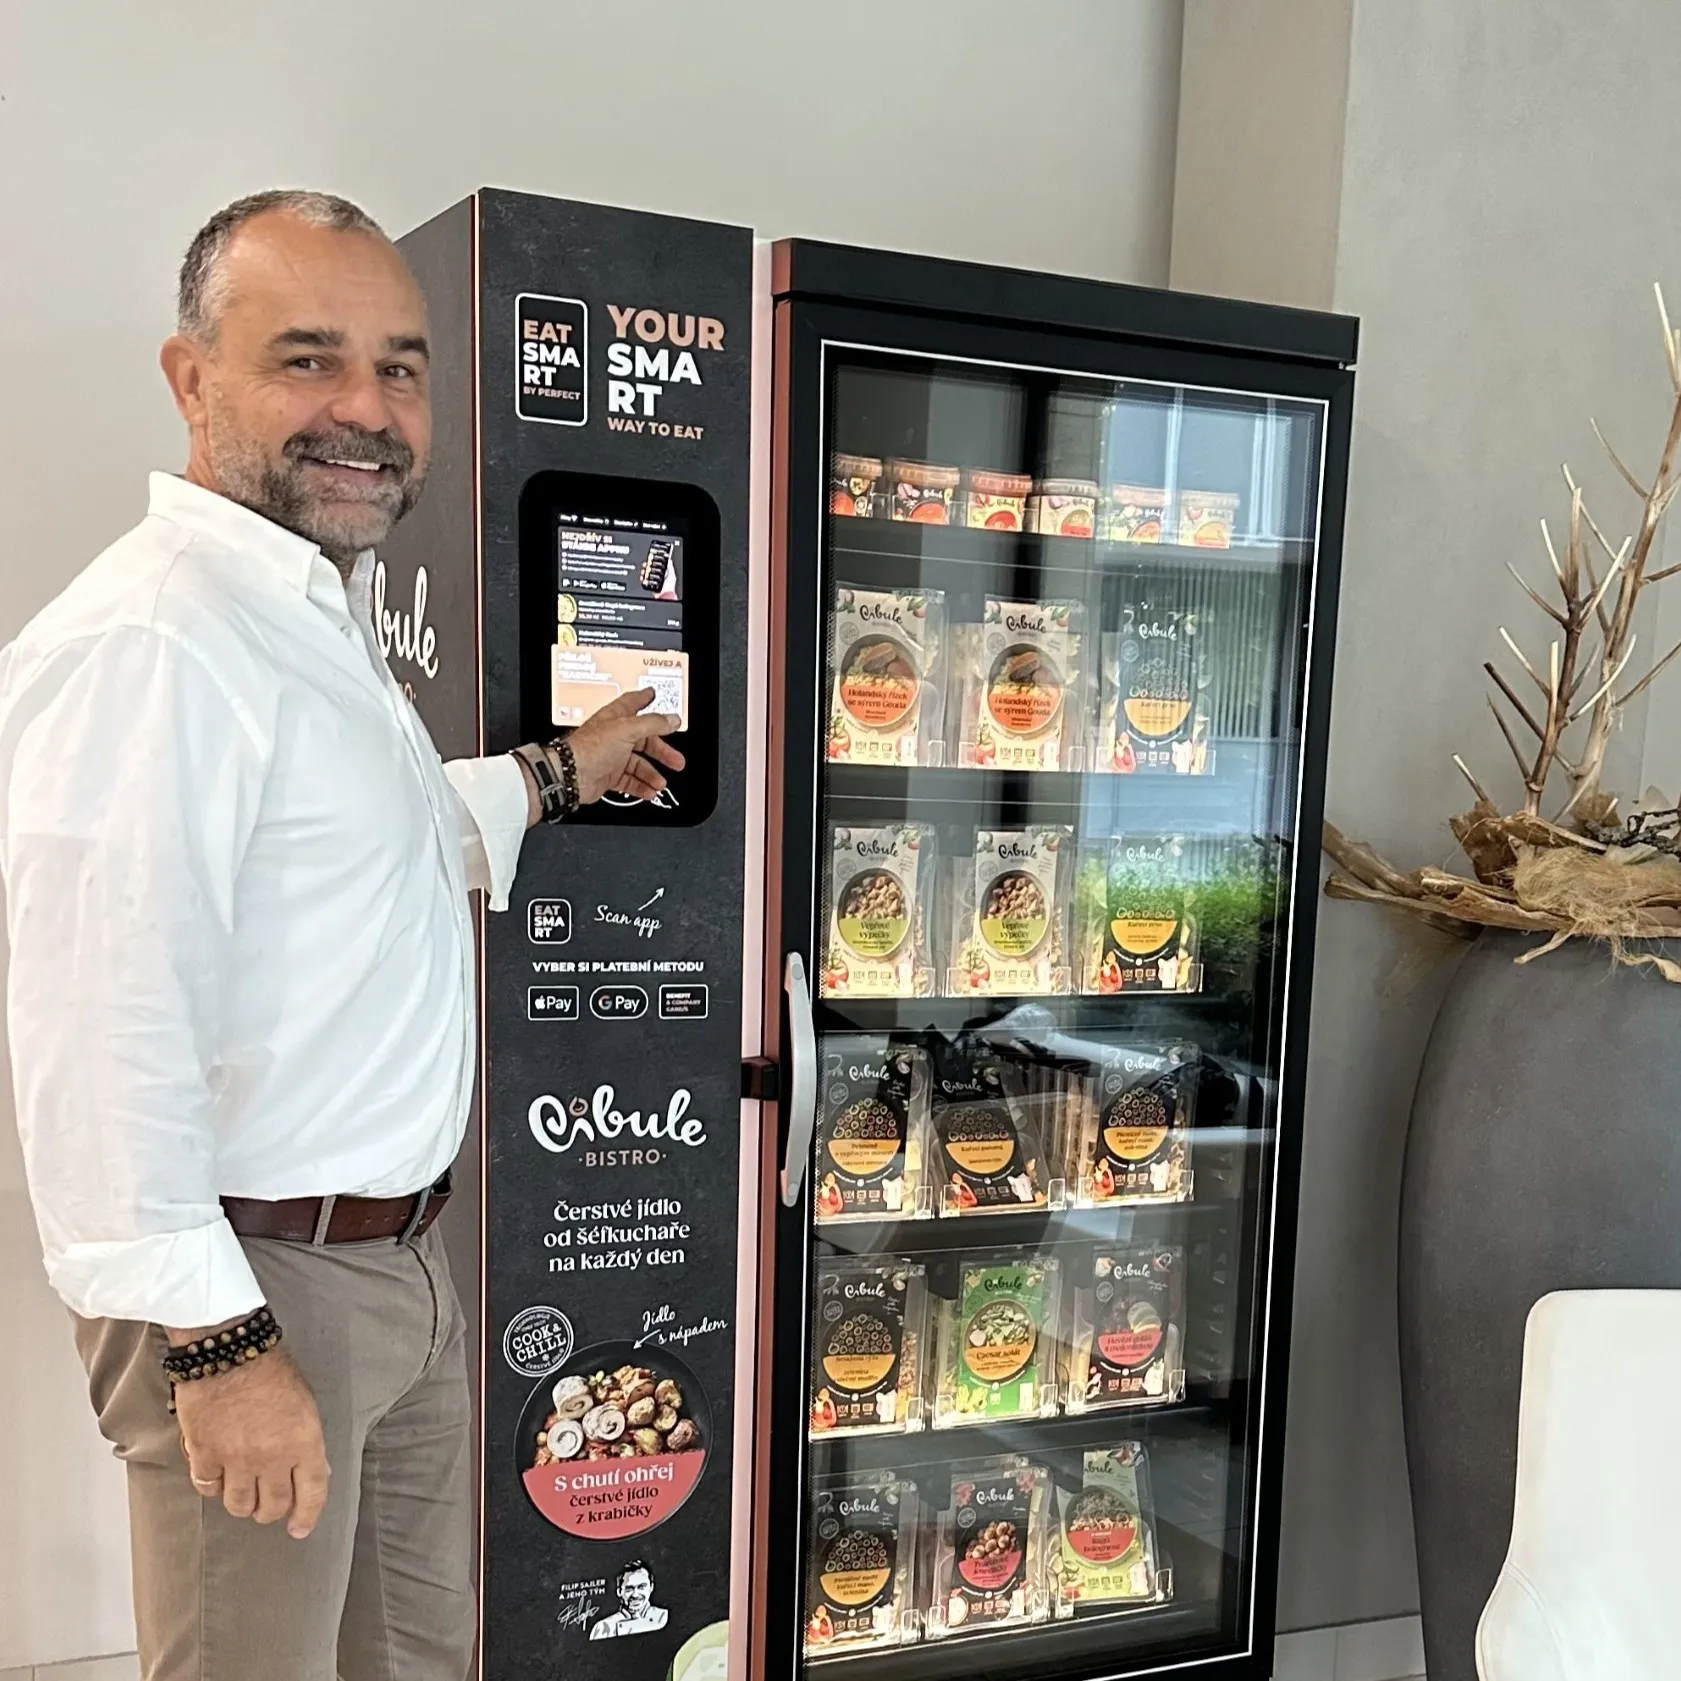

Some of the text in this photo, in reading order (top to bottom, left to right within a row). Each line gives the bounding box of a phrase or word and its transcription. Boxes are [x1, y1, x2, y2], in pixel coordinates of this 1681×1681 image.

[523, 319, 572, 344] EAT
[607, 304, 725, 351] YOUR
[523, 341, 580, 367] SMA
[607, 342, 702, 385] SMA
[523, 364, 557, 387] RT
[523, 386, 581, 400] BY PERFECT
[608, 379, 663, 416] RT
[607, 417, 704, 440] WAY TO EAT
[375, 561, 439, 679] bule
[859, 604, 903, 624] Cibule
[1006, 614, 1047, 634] Cibule
[1139, 622, 1178, 641] Cibule
[857, 839, 899, 858] Cibule
[998, 843, 1038, 859] Cibule
[1126, 845, 1166, 862] Cibule
[534, 905, 560, 916] EAT
[534, 916, 565, 927] SMA
[594, 904, 662, 938] Scan app
[534, 927, 552, 938] RT
[532, 960, 704, 973] VYBER SI PLATEBNÍ METODU
[547, 996, 572, 1012] Pay
[615, 996, 640, 1013] Pay
[849, 1063, 890, 1081] Cibule
[528, 1084, 707, 1153] Cibule
[584, 1149, 661, 1167] BISTRO
[553, 1198, 682, 1222] Čerstvé jídlo
[543, 1221, 691, 1248] od šéfkuchaře
[549, 1248, 685, 1273] na každý den
[1113, 1263, 1151, 1280] Cibule
[844, 1282, 886, 1299] Cibule
[642, 1304, 676, 1333] Jídlo
[658, 1317, 728, 1346] s nápadem
[516, 1333, 567, 1363] CHILL
[554, 1462, 674, 1492] S chutí ohřej
[569, 1486, 659, 1508] čerstvé jídlo
[839, 1498, 880, 1516] Cibule
[576, 1504, 653, 1525] z krabičky
[561, 1579, 606, 1591] FILIP SAILER
[589, 1587, 605, 1596] TÝM
